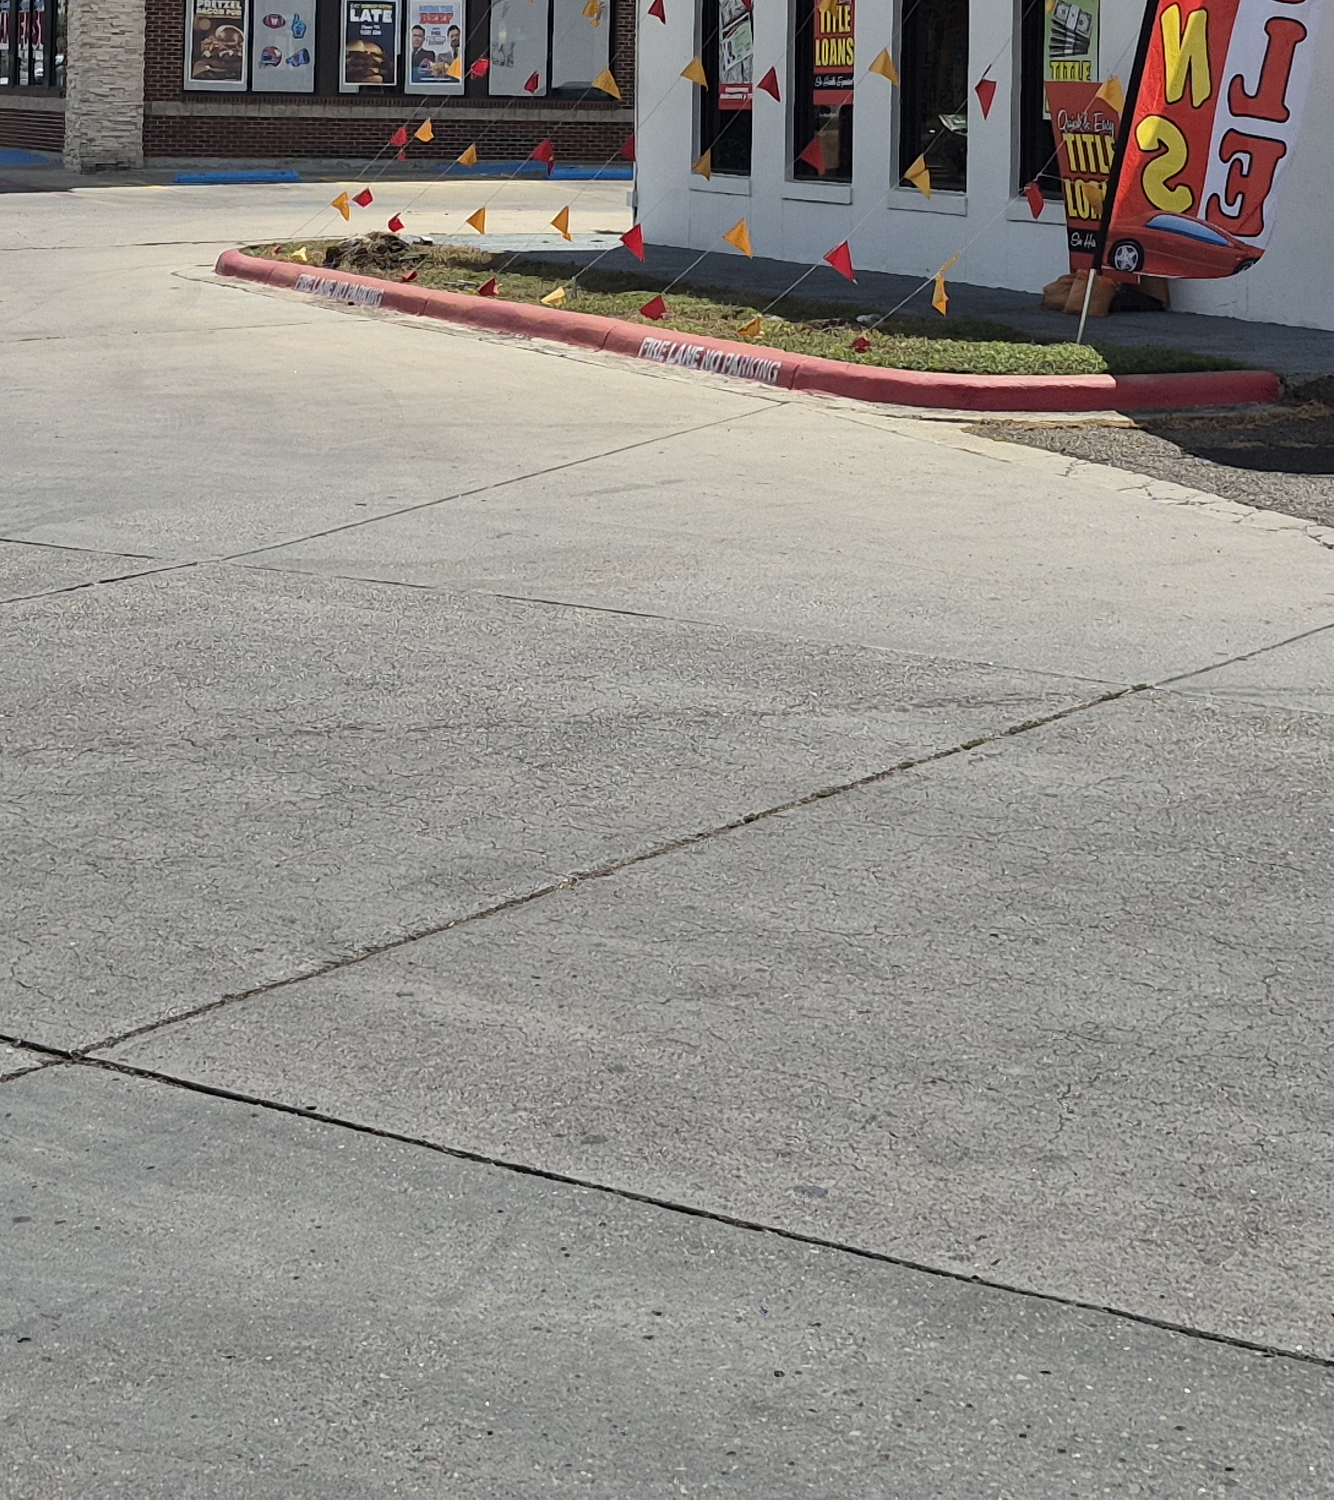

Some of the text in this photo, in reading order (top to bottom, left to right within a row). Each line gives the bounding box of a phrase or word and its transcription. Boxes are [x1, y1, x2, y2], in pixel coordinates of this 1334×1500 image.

[350, 8, 393, 24] LATE
[815, 38, 854, 66] LOANS
[1050, 61, 1092, 82] TITLE
[1062, 133, 1115, 174] TITLE
[638, 337, 781, 384] FIRE LANE NO PARKING
